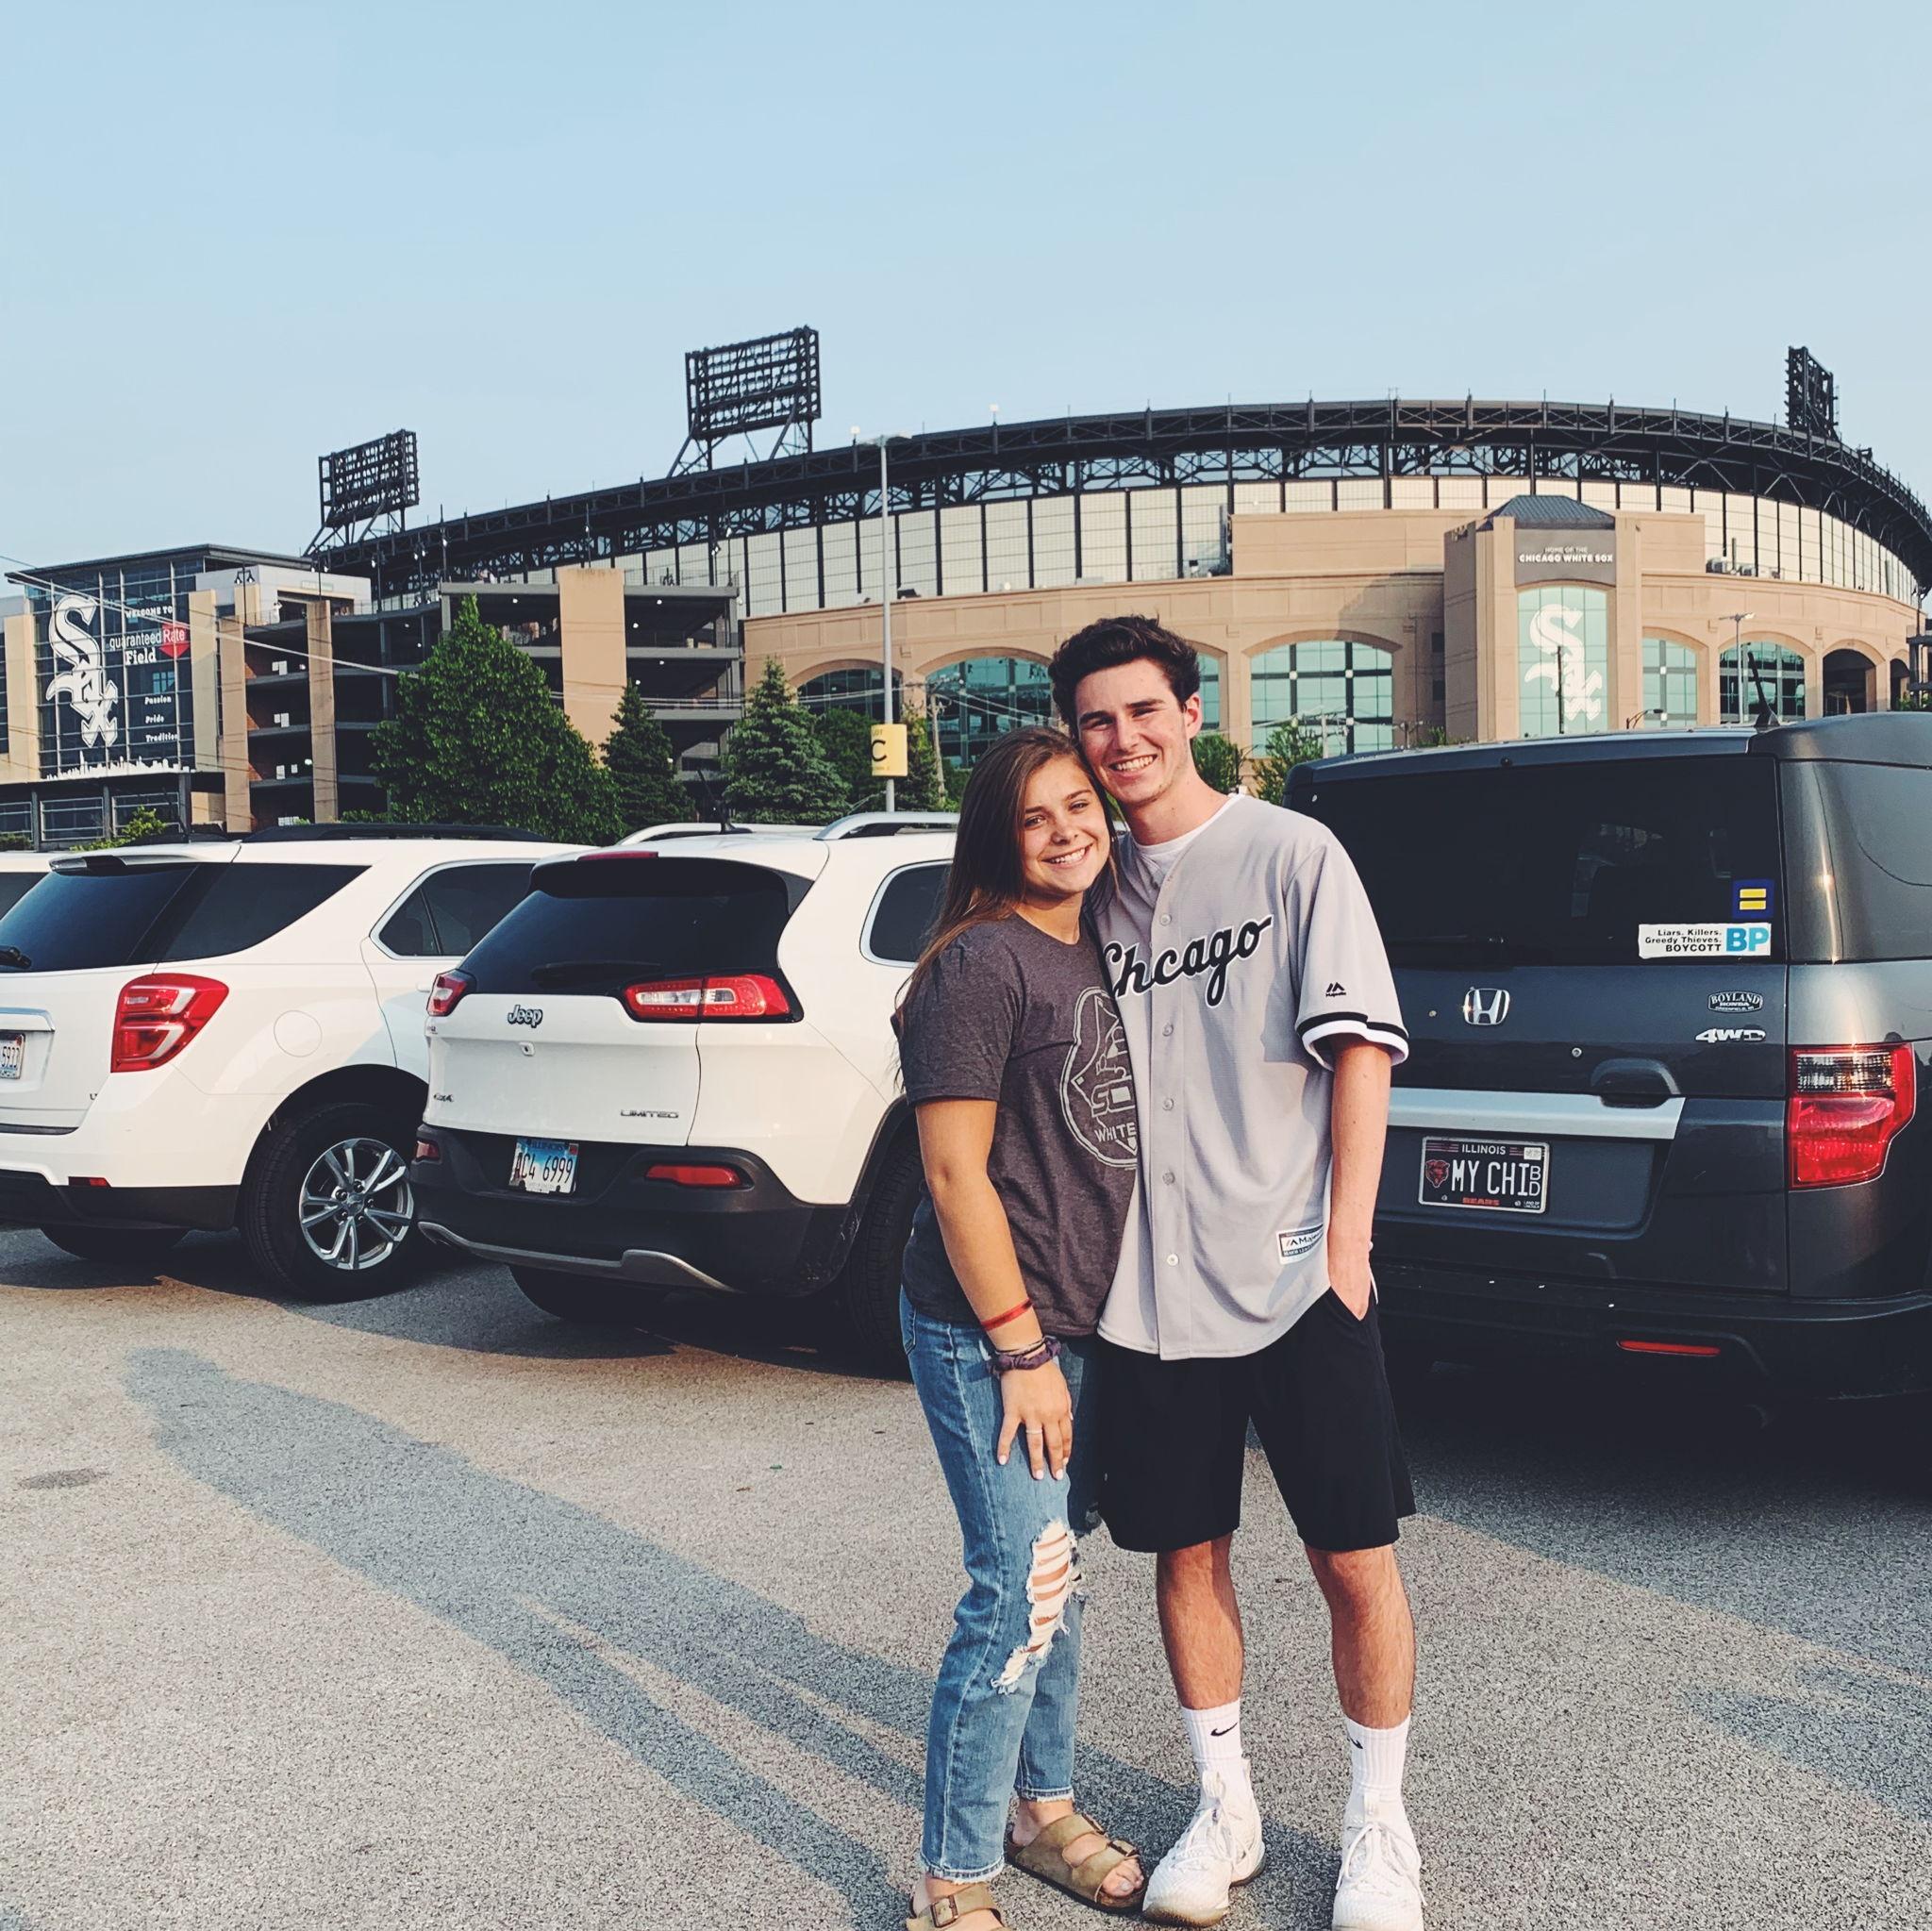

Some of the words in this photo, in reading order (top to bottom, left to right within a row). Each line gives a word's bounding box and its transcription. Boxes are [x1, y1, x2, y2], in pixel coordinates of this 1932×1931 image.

[1519, 554, 1561, 562] CHICAGO
[1563, 554, 1593, 562] WHITE
[1595, 554, 1613, 562] SOX
[125, 606, 161, 618] WELCOME
[162, 606, 174, 614] TO
[109, 631, 161, 651] guaranteed
[162, 628, 186, 643] Rate
[125, 647, 157, 666] Field
[144, 695, 172, 705] Passion
[145, 714, 165, 724] Pride
[145, 732, 179, 742] Tradition
[872, 740, 888, 762] C
[1726, 927, 1770, 952] BP
[1711, 992, 1760, 1005] BOYLAND
[508, 1005, 543, 1028] Jeep
[1695, 1028, 1766, 1043] 4WD
[621, 1109, 678, 1119] LIMITED
[1094, 1123, 1137, 1143] WHITE
[1461, 1143, 1507, 1156] ILLINOIS
[514, 1152, 536, 1180] AC4
[542, 1156, 574, 1184] 6999
[1451, 1159, 1480, 1193] MY
[1462, 1197, 1500, 1207] BEARS
